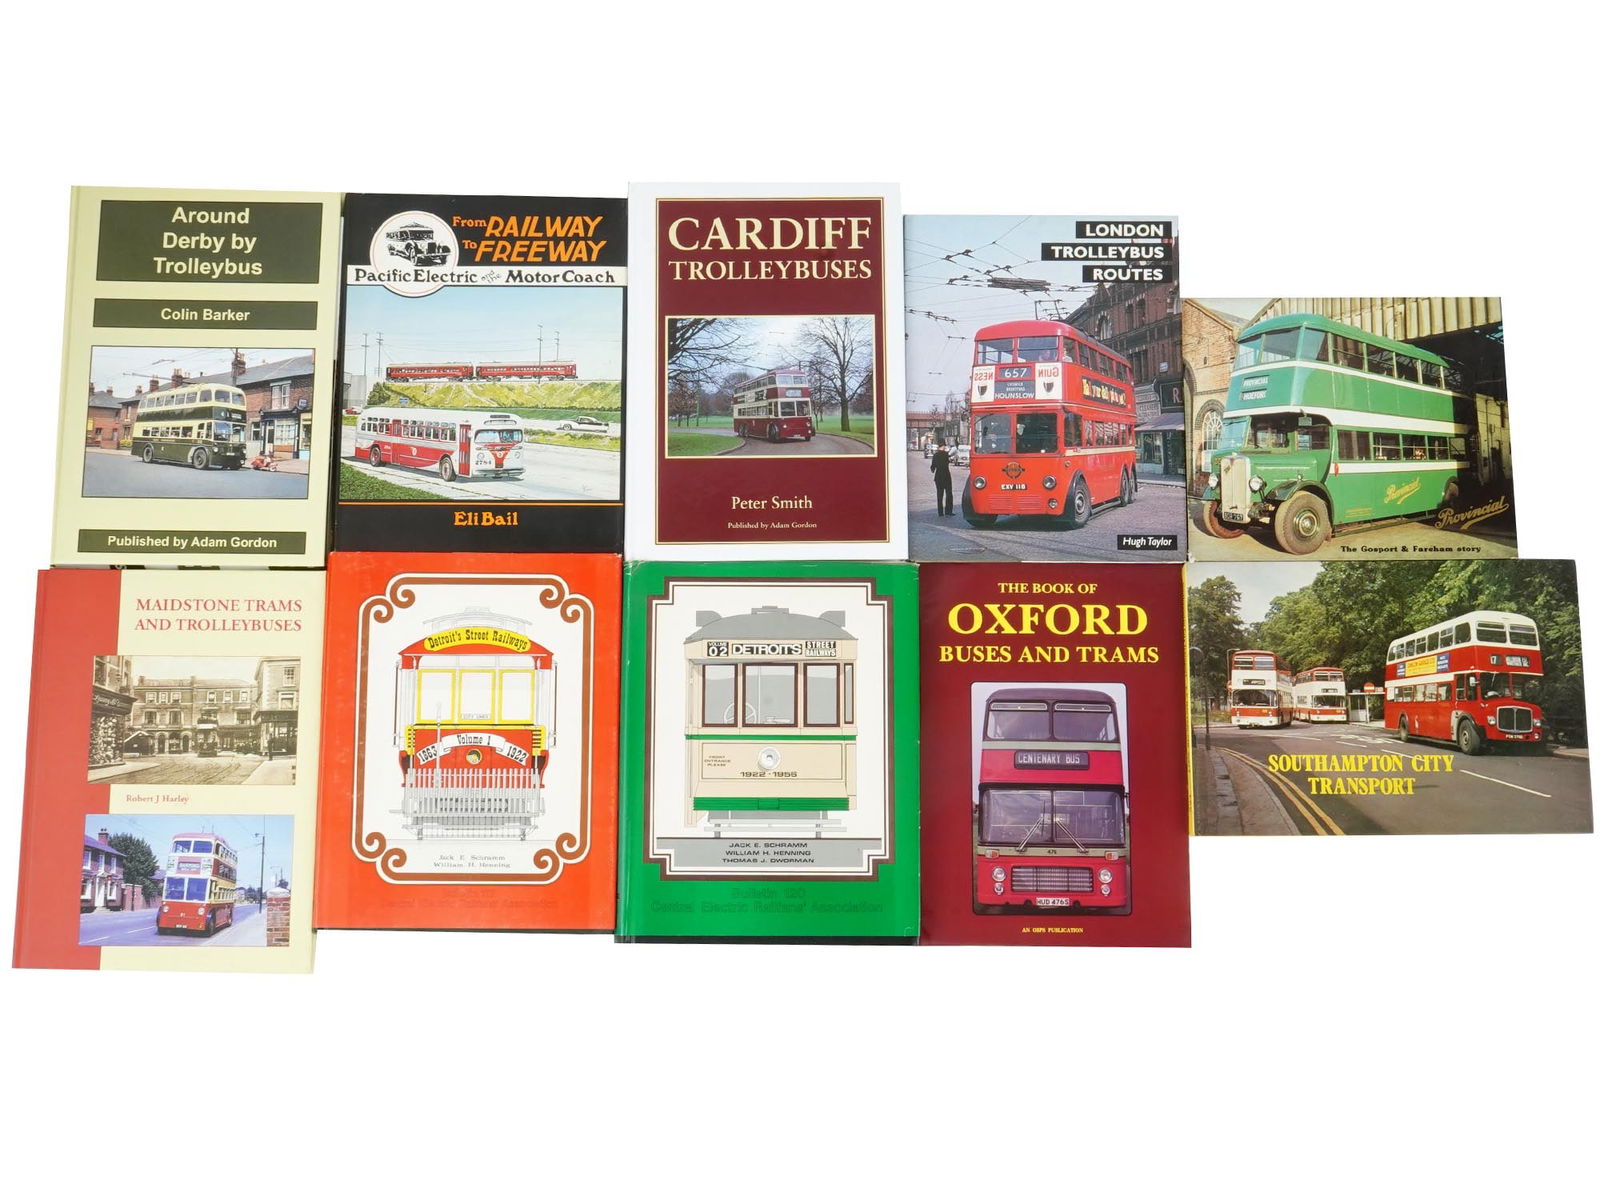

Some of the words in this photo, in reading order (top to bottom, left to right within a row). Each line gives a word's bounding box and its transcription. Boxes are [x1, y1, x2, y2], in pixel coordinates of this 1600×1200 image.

[171, 206, 250, 224] Around
[452, 216, 487, 228] From
[485, 216, 603, 238] RAILWAY
[668, 217, 872, 250] CARDIFF
[1086, 224, 1164, 237] LONDON
[163, 232, 225, 253] Derby
[231, 233, 257, 254] by
[462, 240, 477, 249] To
[475, 240, 607, 262] FREEWAY
[1051, 245, 1164, 259] TROLLEYBUS
[153, 256, 263, 279] Trolleybus
[668, 259, 872, 281] TROLLEYBUSES
[1093, 268, 1163, 281] ROUTES
[355, 268, 411, 283] Pacific
[414, 269, 478, 283] Electric
[505, 270, 560, 283] Motor
[562, 270, 615, 283] Coach
[160, 307, 198, 320] Colin
[203, 308, 250, 321] Barker
[1004, 368, 1027, 378] 657
[995, 392, 1035, 400] HOUNSLOW
[732, 496, 768, 510] Peter
[771, 495, 813, 509] Smith
[454, 511, 478, 526] Eli
[481, 511, 518, 526] Bail
[1434, 496, 1510, 530] Provincial
[727, 521, 759, 529] Published
[760, 521, 769, 530] by
[770, 521, 790, 529] Adam
[791, 521, 817, 529] Gordon
[108, 535, 170, 547] Published
[172, 536, 188, 549] by
[191, 536, 226, 548] Adam
[231, 536, 277, 548] Gordon
[1123, 537, 1146, 547] Hugh
[1147, 537, 1172, 547] Taylor
[1361, 545, 1398, 553] Gosport
[998, 583, 1029, 593] THE
[1032, 583, 1075, 594] BOOK
[1077, 583, 1097, 594] OF
[136, 598, 240, 612] MAIDSTONE
[244, 599, 302, 612] TRAMS
[135, 618, 171, 631] AND
[176, 619, 302, 632] TROLLEYBUSES
[948, 603, 1148, 635] OXFORD
[428, 631, 462, 649] Detroit's
[465, 629, 489, 641] Street
[492, 630, 528, 650] Railways
[806, 641, 834, 649] STREET
[709, 646, 728, 657] 02
[805, 648, 836, 657] RAILWAYS
[939, 645, 1012, 663] BUSES
[1017, 646, 1070, 663] AND
[1076, 646, 1159, 663] TRAMS
[457, 734, 483, 745] Volume
[418, 745, 438, 762] 1863
[506, 745, 528, 763] 1922
[1018, 752, 1061, 764] CENTENARY
[1065, 752, 1080, 764] BUS
[1268, 753, 1403, 773] SOUTHAMPTON
[1411, 753, 1455, 773] CITY
[1308, 777, 1416, 795] TRANSPORT
[125, 794, 153, 803] Robert
[154, 794, 160, 804] J
[162, 794, 190, 805] Harley
